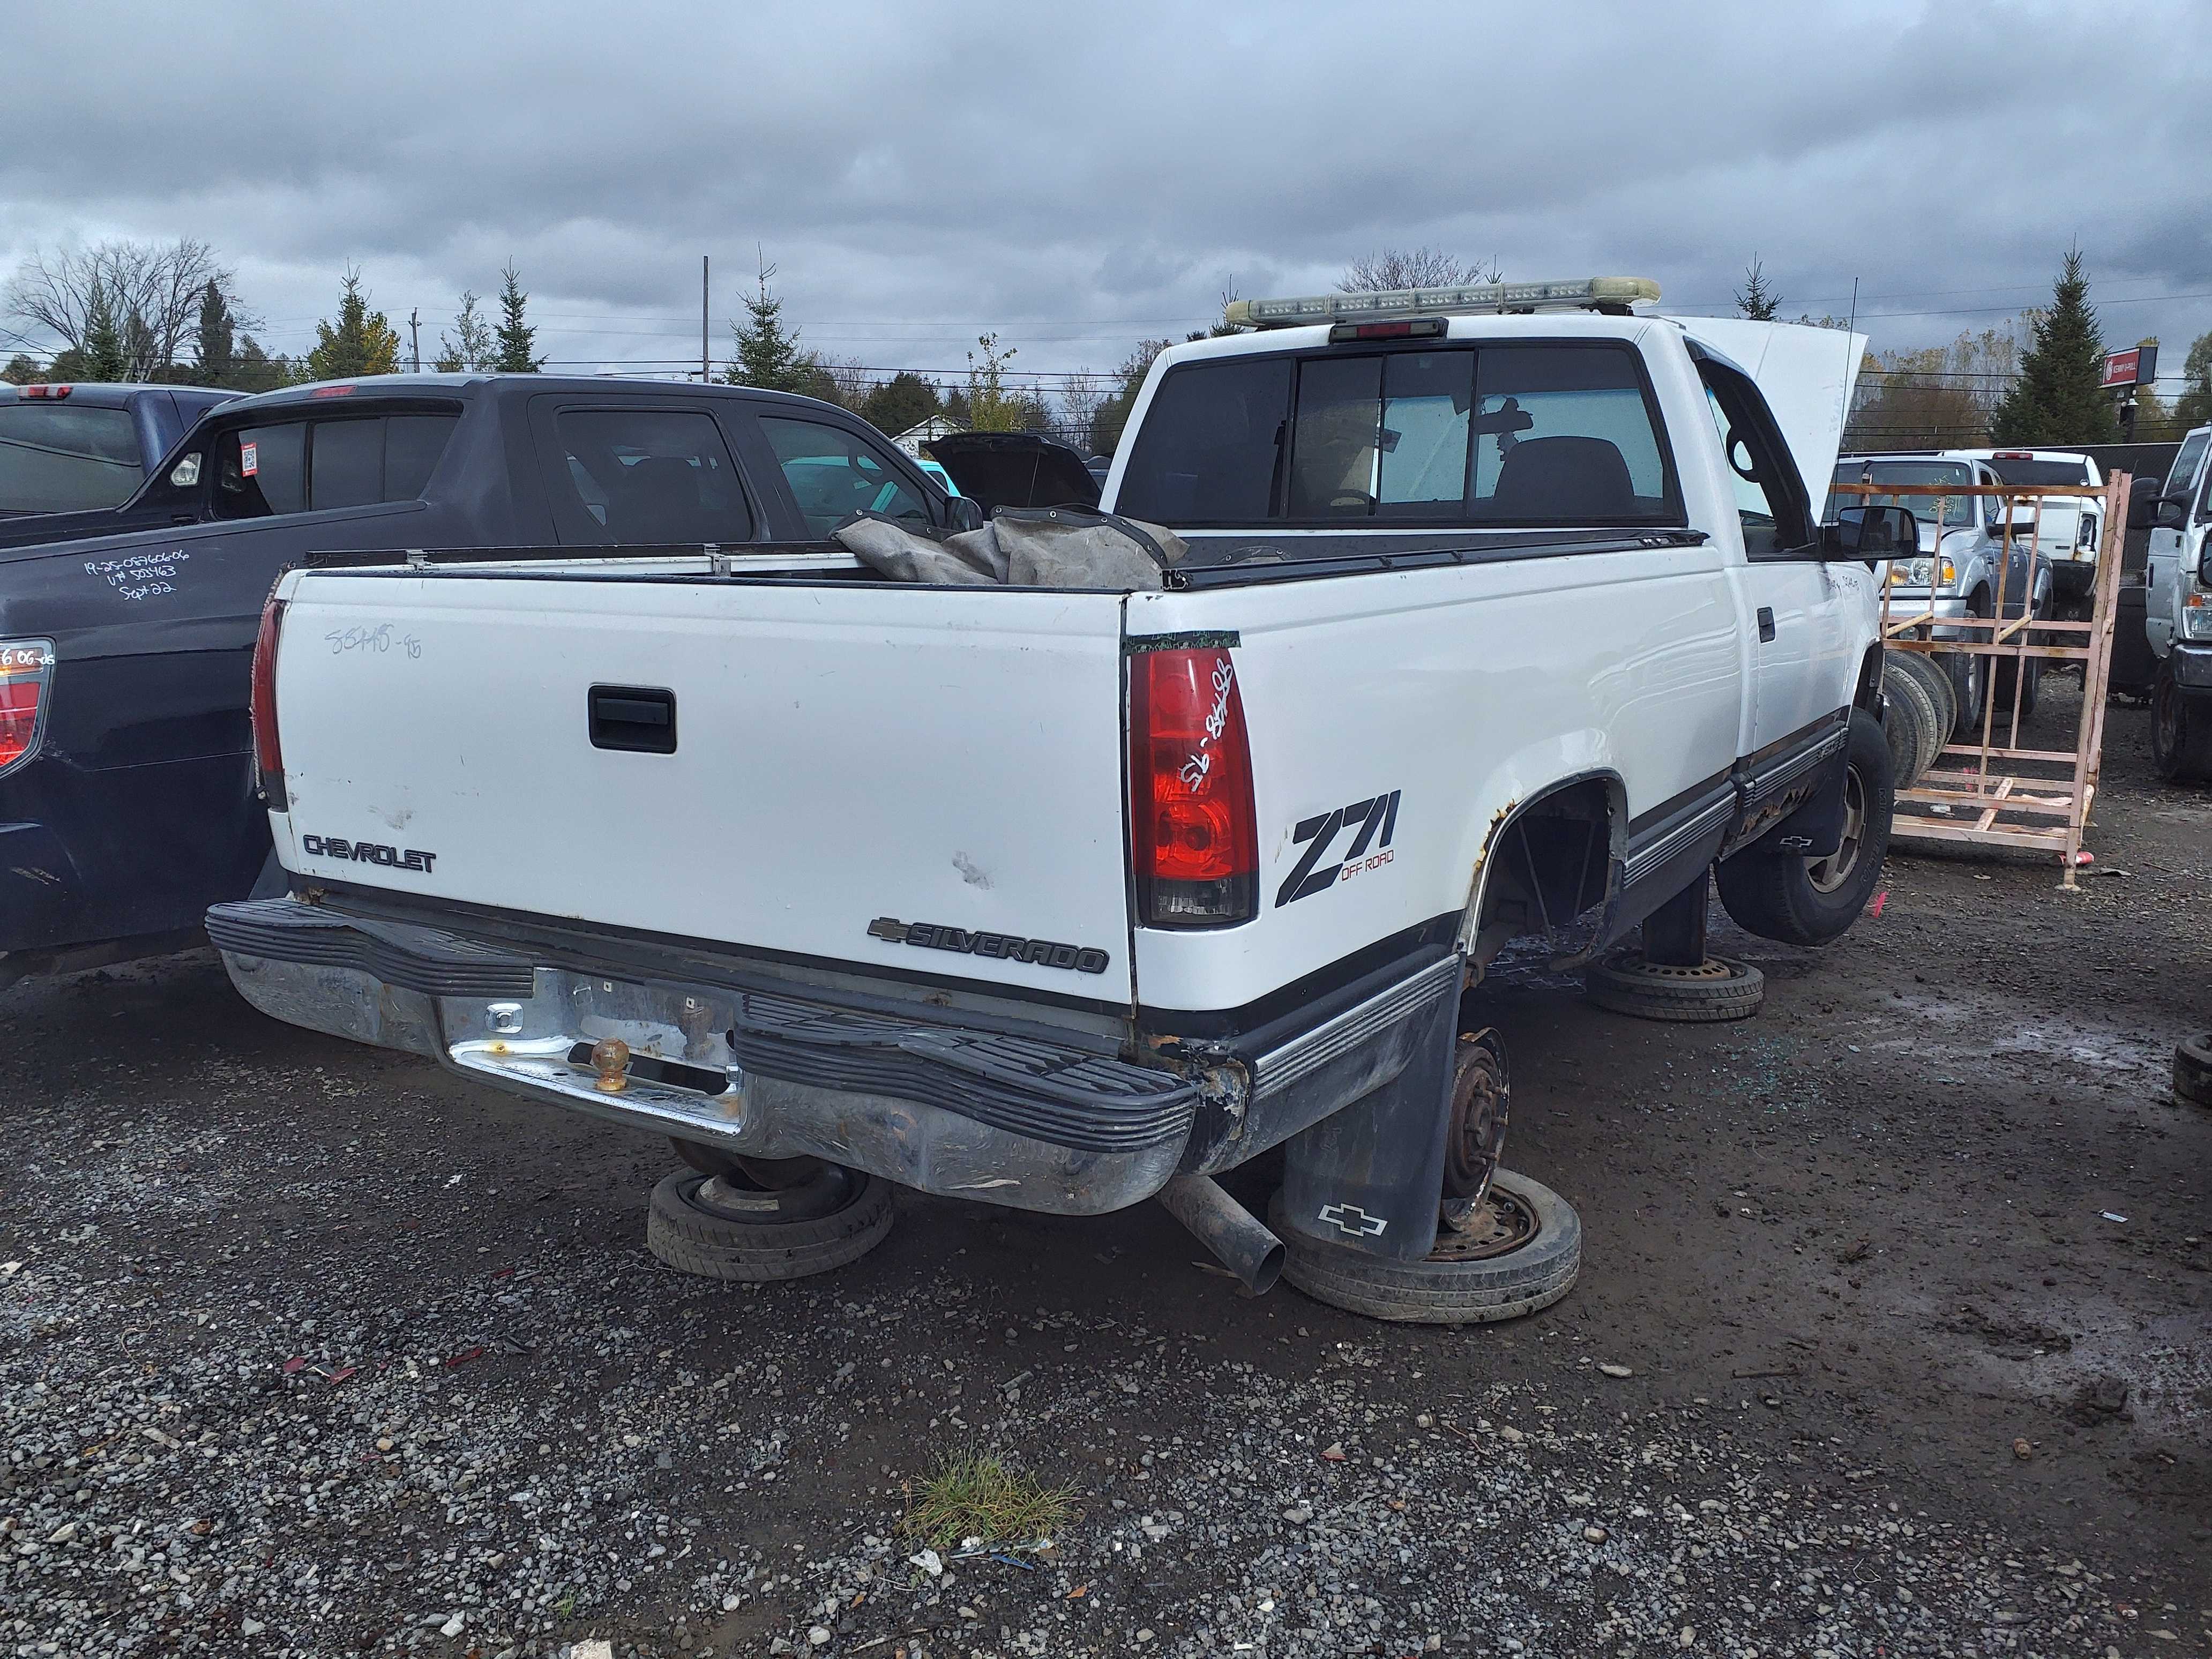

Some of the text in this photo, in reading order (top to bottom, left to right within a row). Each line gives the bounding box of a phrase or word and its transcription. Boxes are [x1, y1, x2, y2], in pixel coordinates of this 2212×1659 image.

[130, 565, 176, 580] 503463
[303, 834, 437, 873] CHEVROLET
[1275, 789, 1401, 908] Z71
[1342, 849, 1394, 881] OFF ROAD
[906, 922, 1110, 974] SILVERADO
